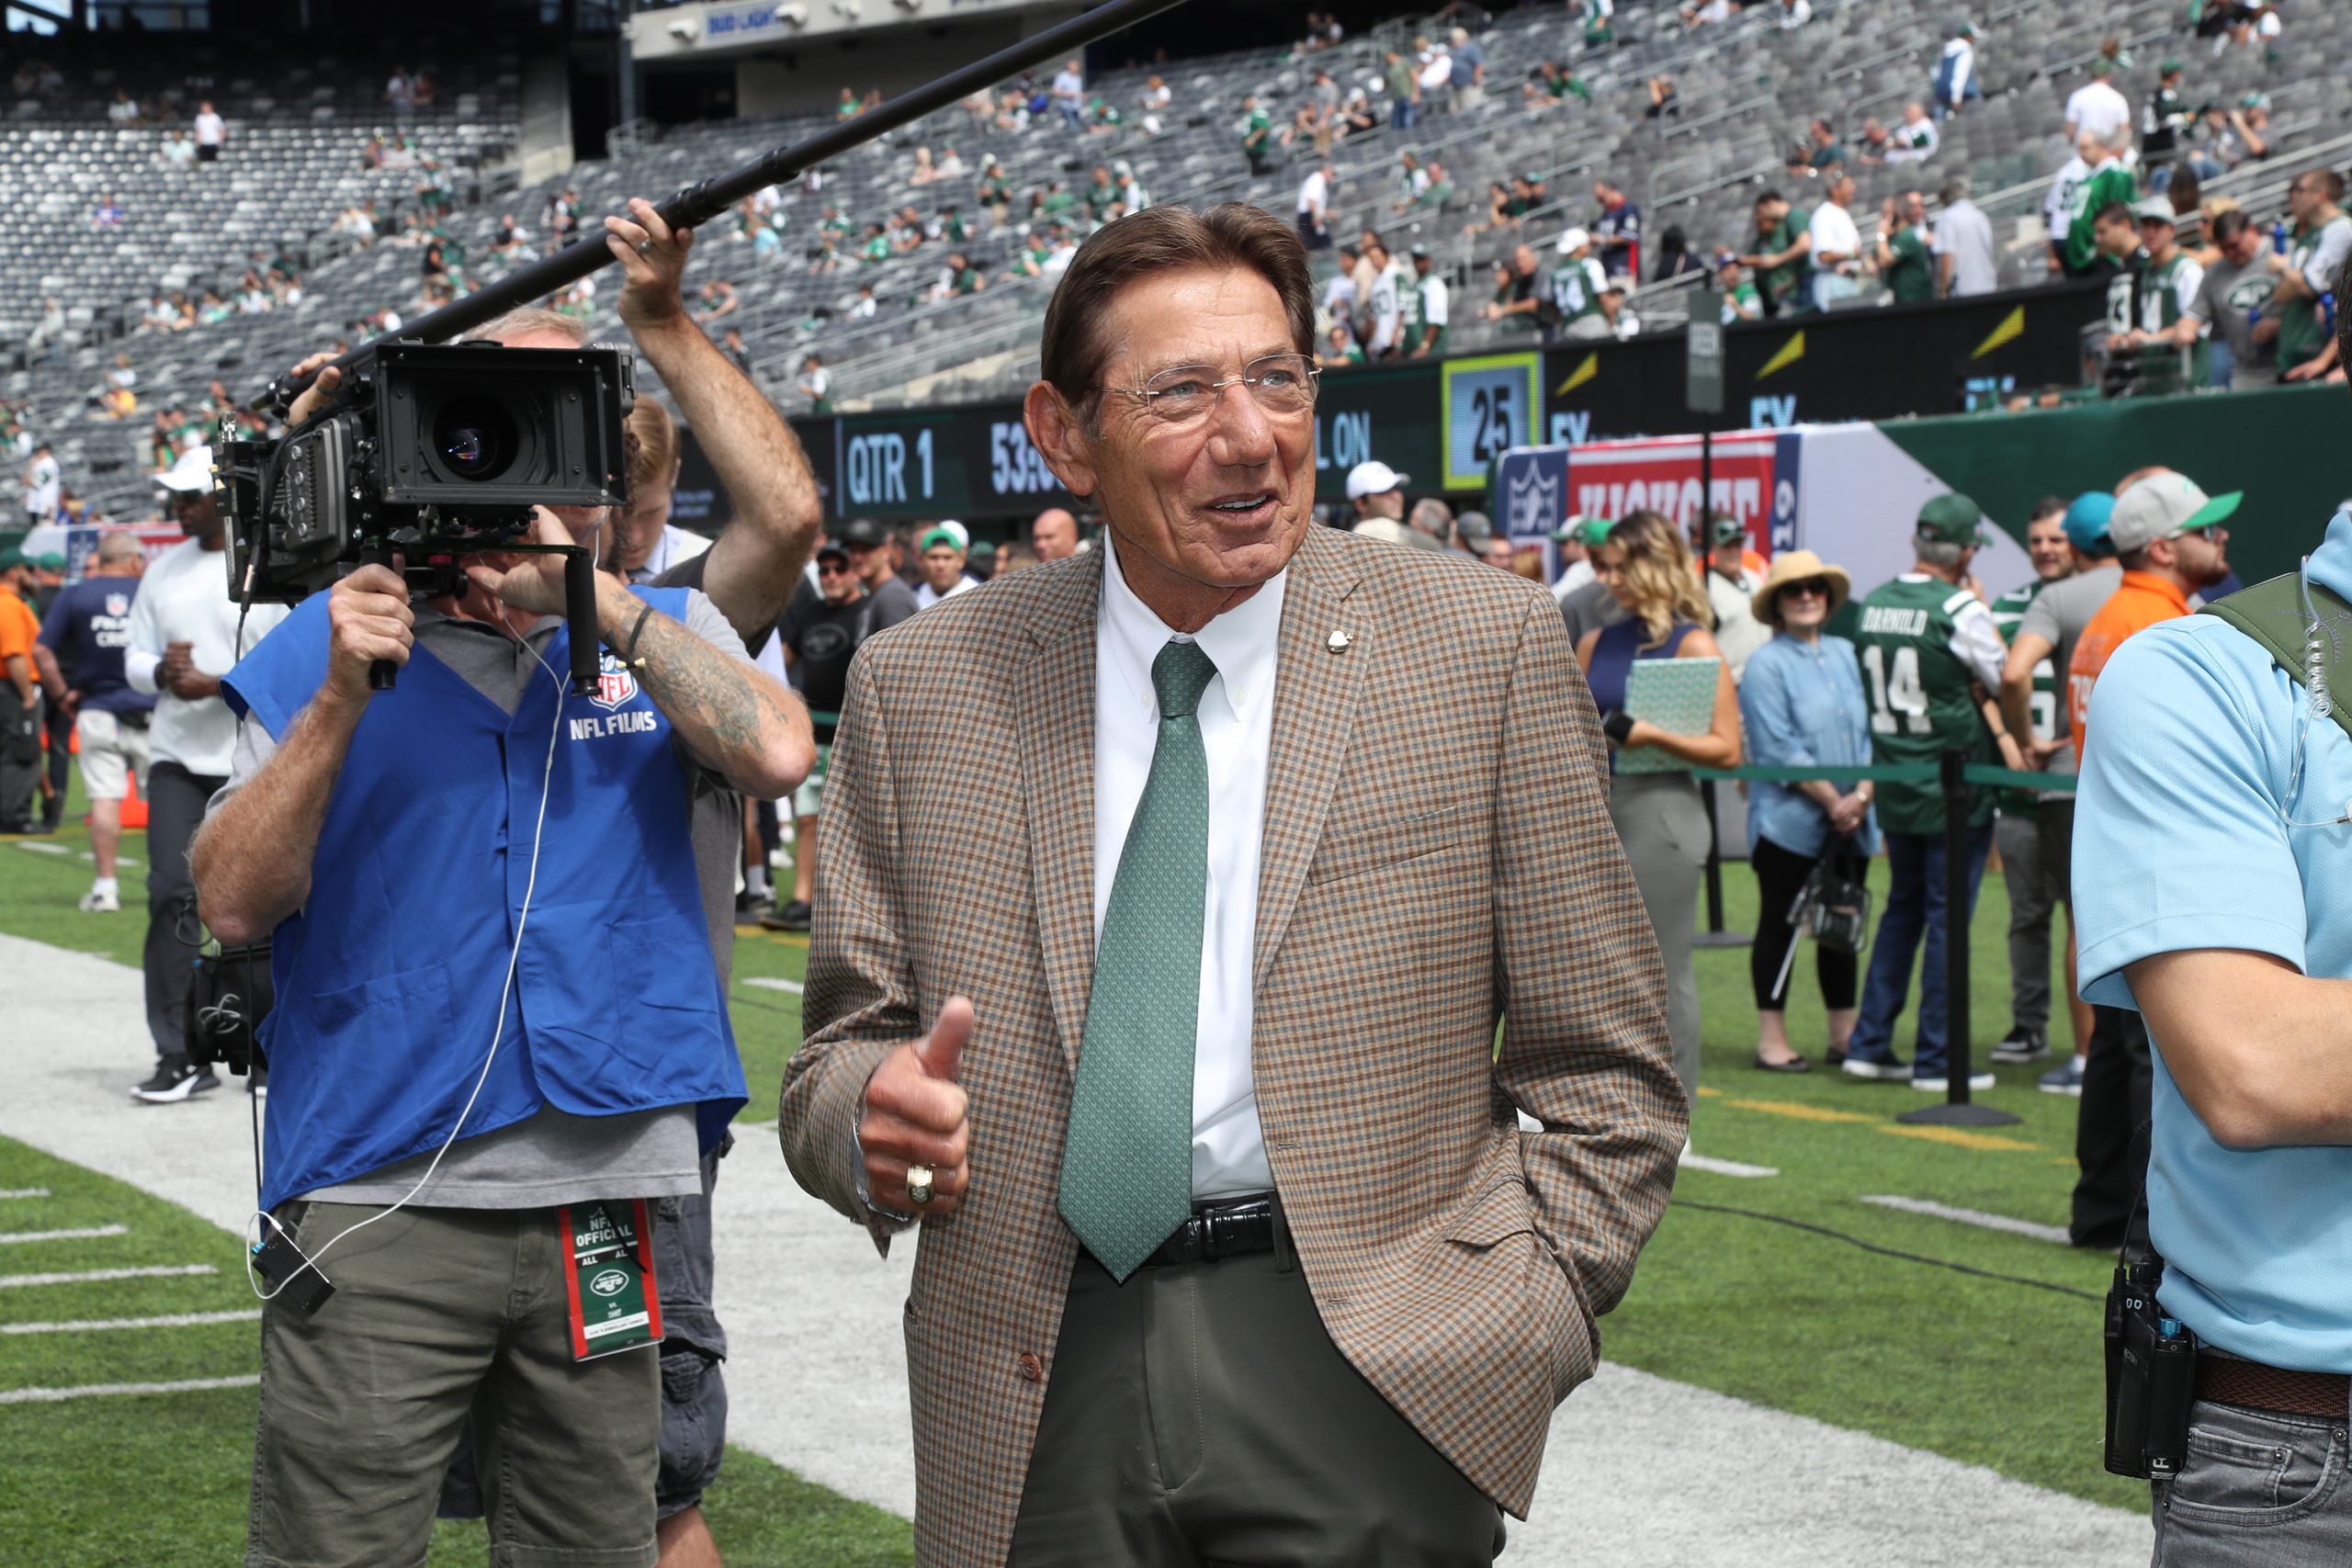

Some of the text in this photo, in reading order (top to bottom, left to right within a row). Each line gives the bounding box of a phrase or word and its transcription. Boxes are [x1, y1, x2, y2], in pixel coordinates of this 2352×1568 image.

[1333, 412, 1371, 469] ON
[1474, 386, 1512, 463] 25
[848, 428, 933, 503] QTR 1
[991, 423, 1066, 494] 53:
[1861, 605, 1928, 636] DARNOLD
[1863, 645, 1933, 734] 14
[570, 711, 657, 740] NFL FILMS
[582, 1256, 598, 1267] ALL
